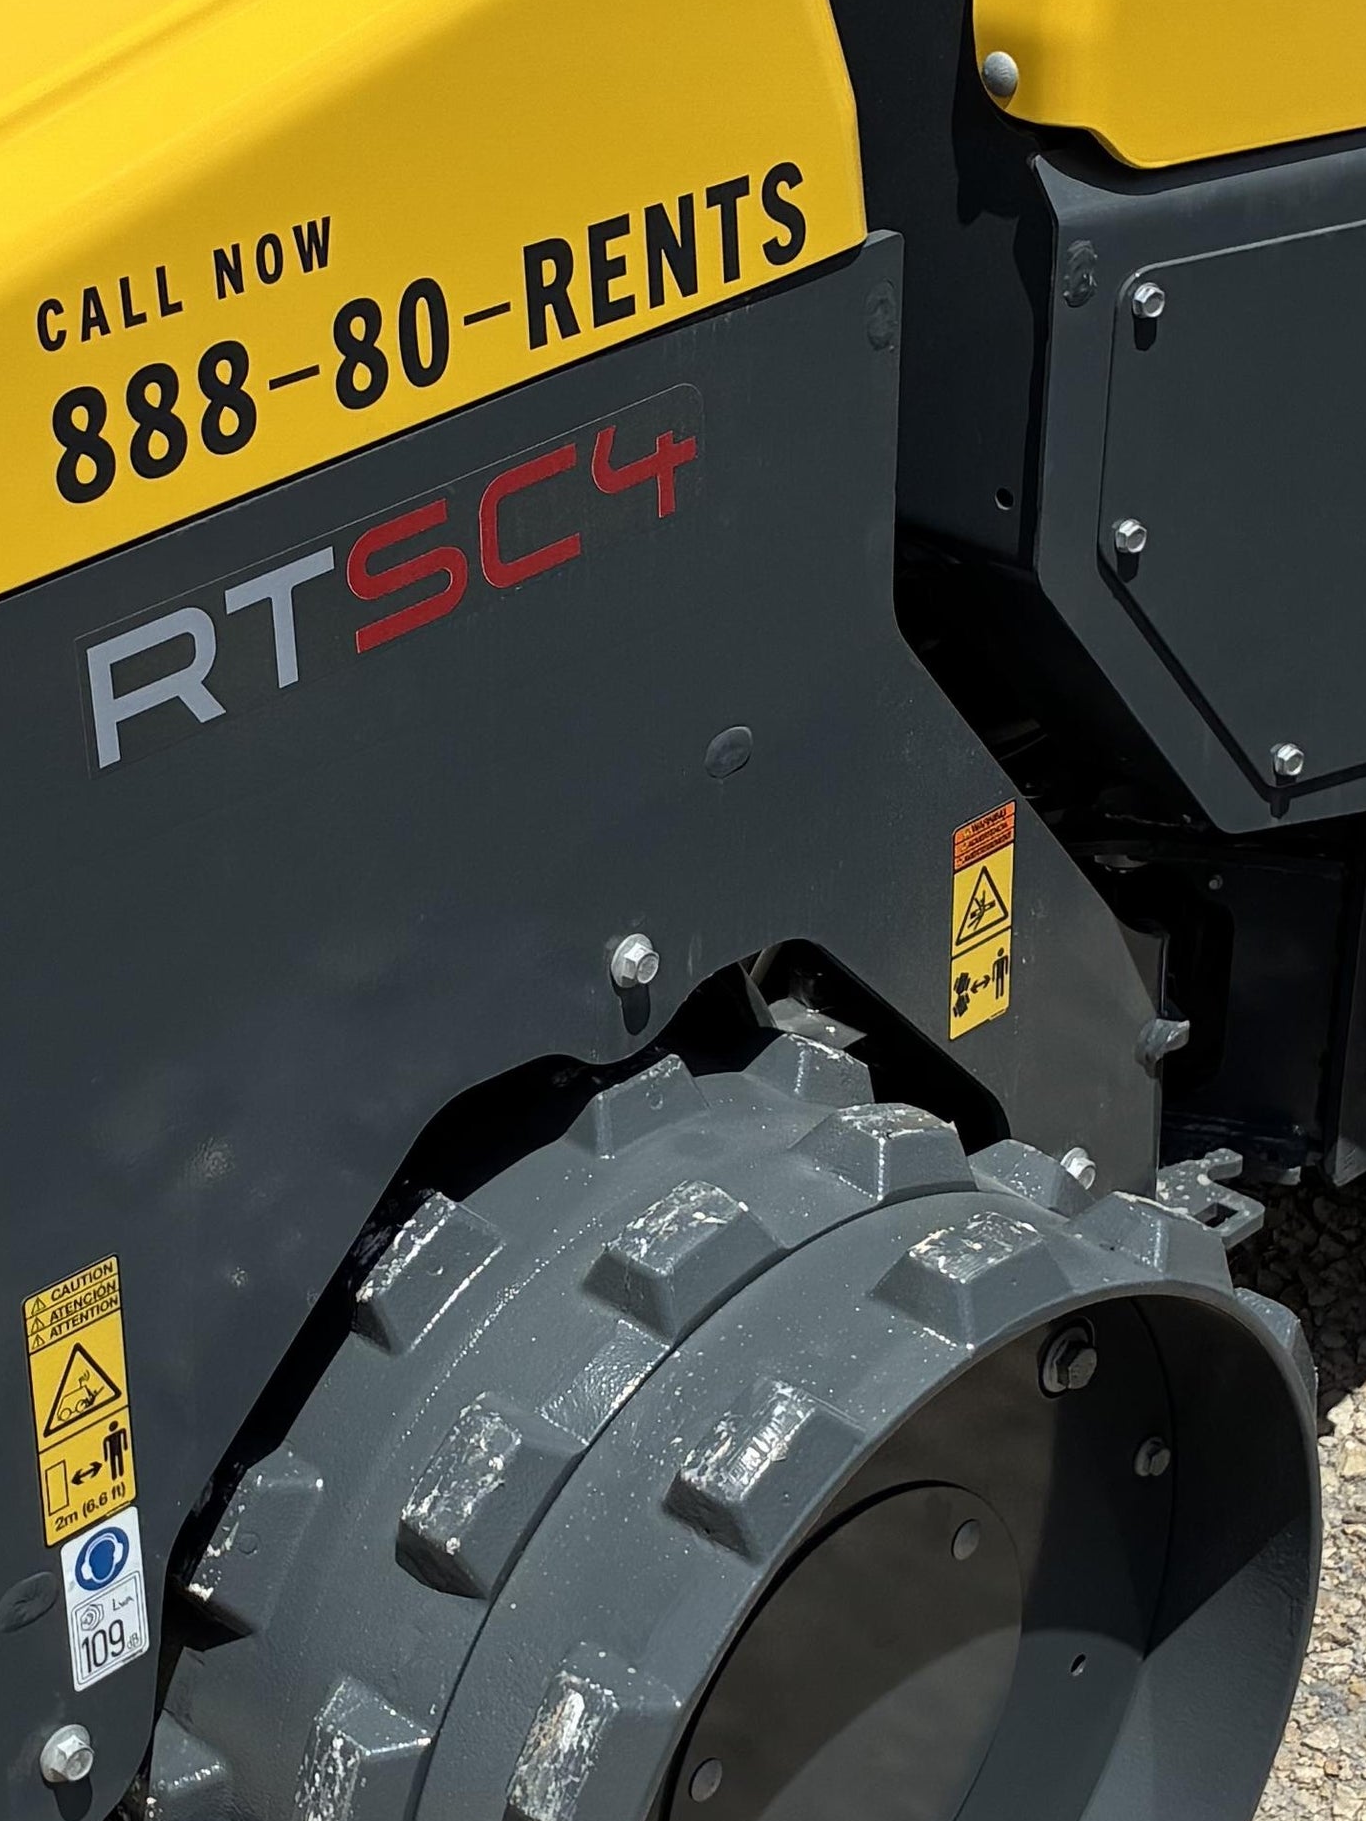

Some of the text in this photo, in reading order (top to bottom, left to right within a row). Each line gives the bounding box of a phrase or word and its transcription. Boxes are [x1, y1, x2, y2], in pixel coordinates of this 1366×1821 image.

[37, 216, 333, 353] CALL NOW
[51, 161, 807, 505] 888-80-RENTS
[86, 426, 698, 770] RTSC4
[51, 1261, 114, 1302] CAUTION
[50, 1295, 119, 1339] ATTENTION
[55, 1513, 78, 1532] 2m
[82, 1618, 126, 1674] 109
